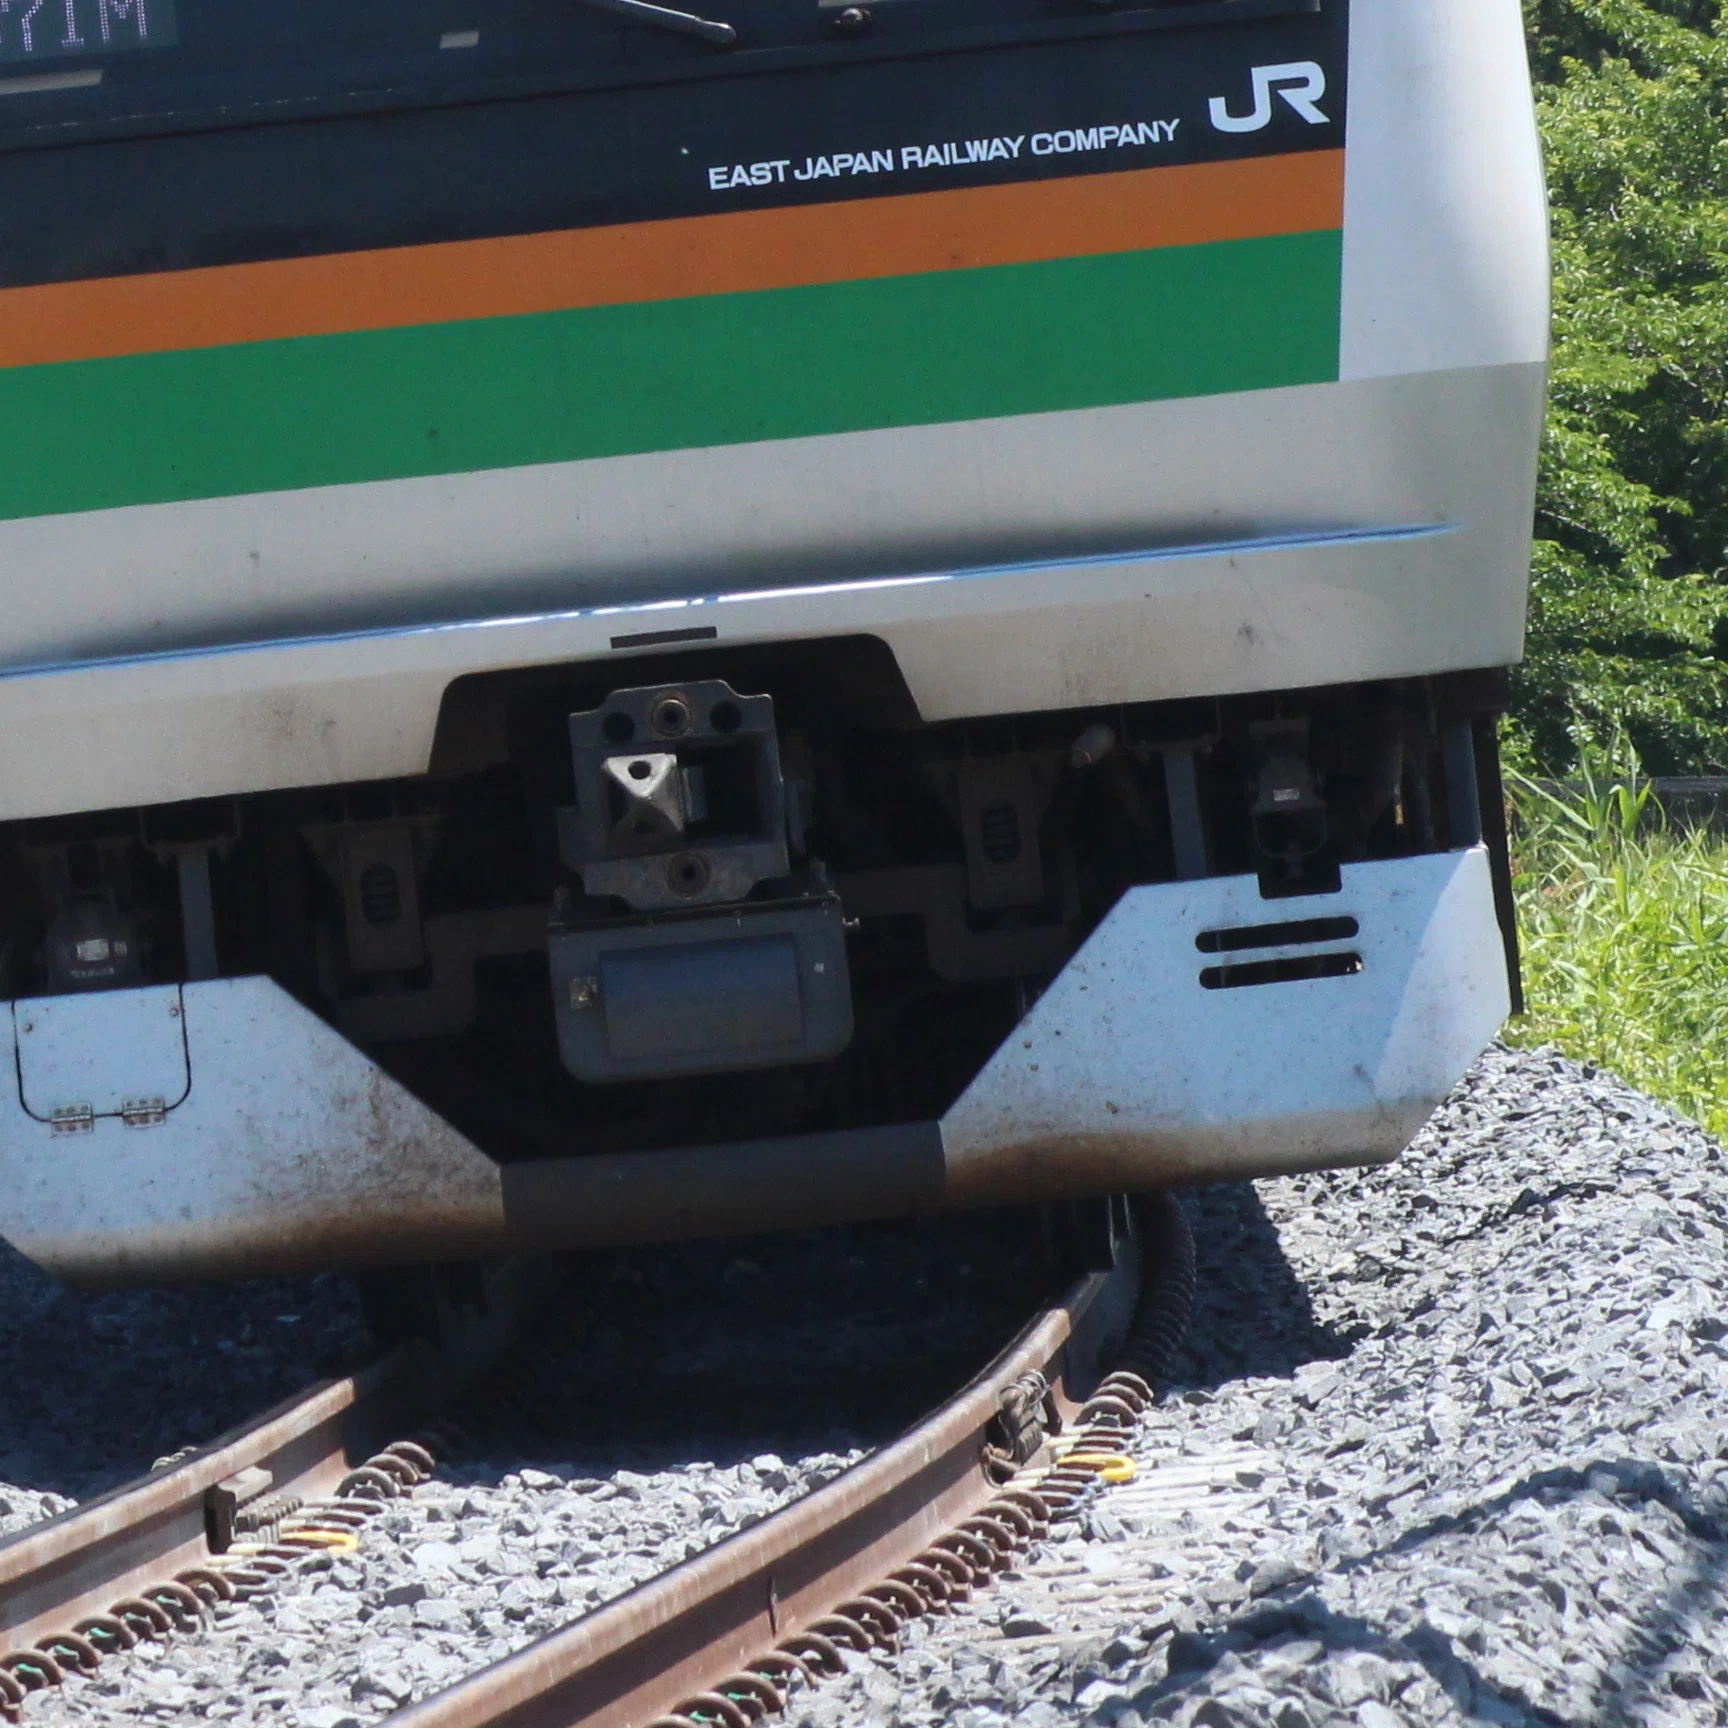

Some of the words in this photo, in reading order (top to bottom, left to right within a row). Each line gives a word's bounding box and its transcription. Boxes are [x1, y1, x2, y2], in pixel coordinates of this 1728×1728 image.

[1207, 60, 1330, 133] JR
[708, 159, 790, 190] EAST
[793, 149, 894, 181] JAPAN
[901, 134, 1026, 170] RAILWAY
[1030, 118, 1181, 156] COMPANY
